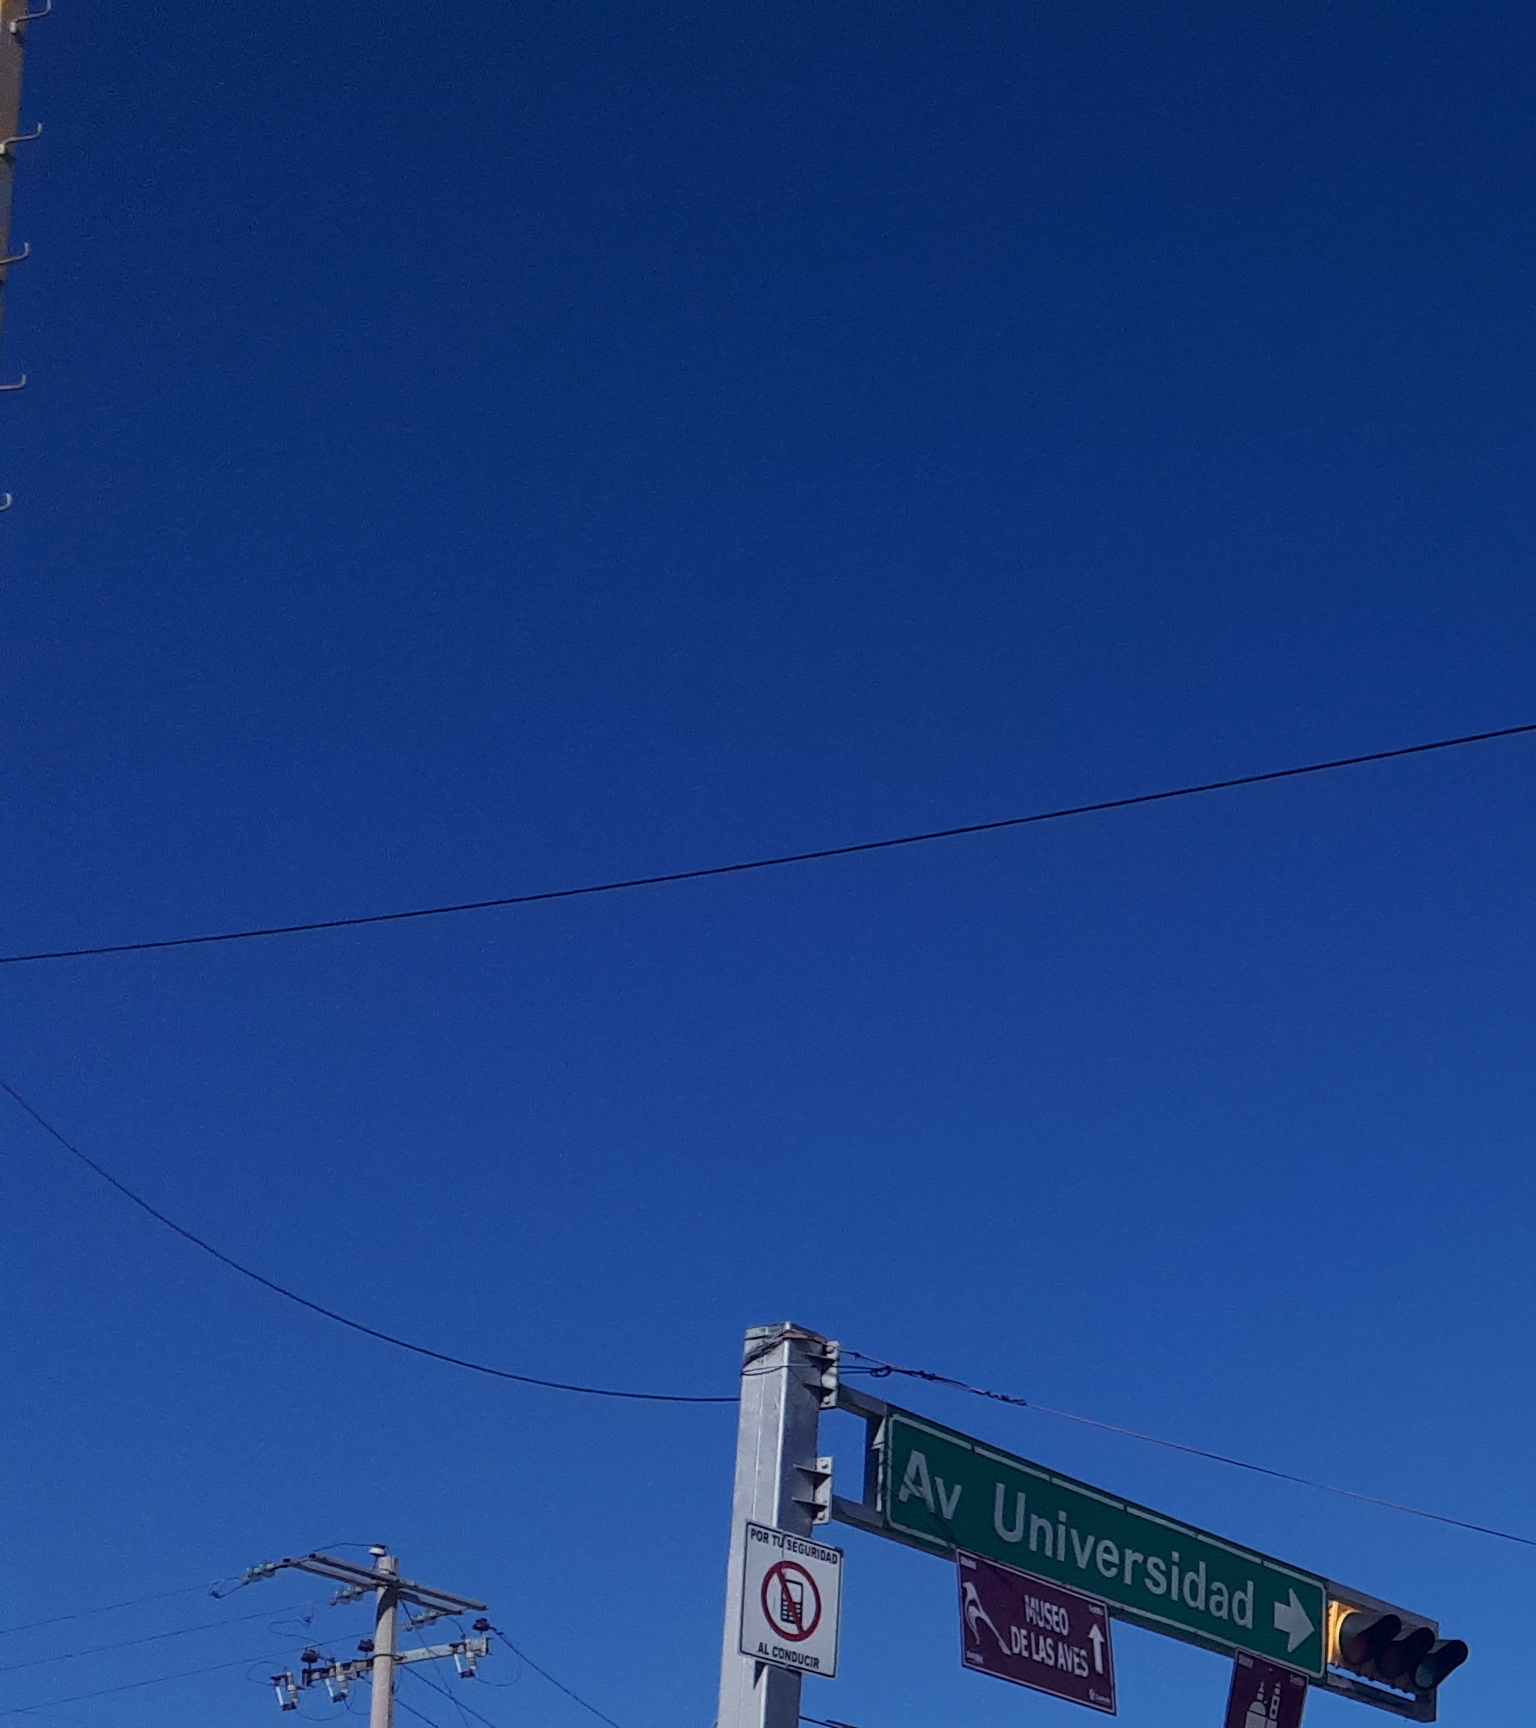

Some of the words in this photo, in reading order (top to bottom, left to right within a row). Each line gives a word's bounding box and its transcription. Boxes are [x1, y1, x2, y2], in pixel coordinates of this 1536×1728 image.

[750, 1527, 769, 1545] POR
[772, 1534, 784, 1548] TU
[786, 1540, 838, 1565] SEGURIDAD
[899, 1449, 963, 1520] Av
[992, 1482, 1255, 1630] Universidad
[1024, 1594, 1070, 1637] MUSEO
[758, 1641, 770, 1656] AL
[772, 1645, 820, 1669] CONDUCIR
[1010, 1624, 1030, 1658] DE
[1030, 1631, 1056, 1667] LAS
[1057, 1641, 1090, 1678] AVES
